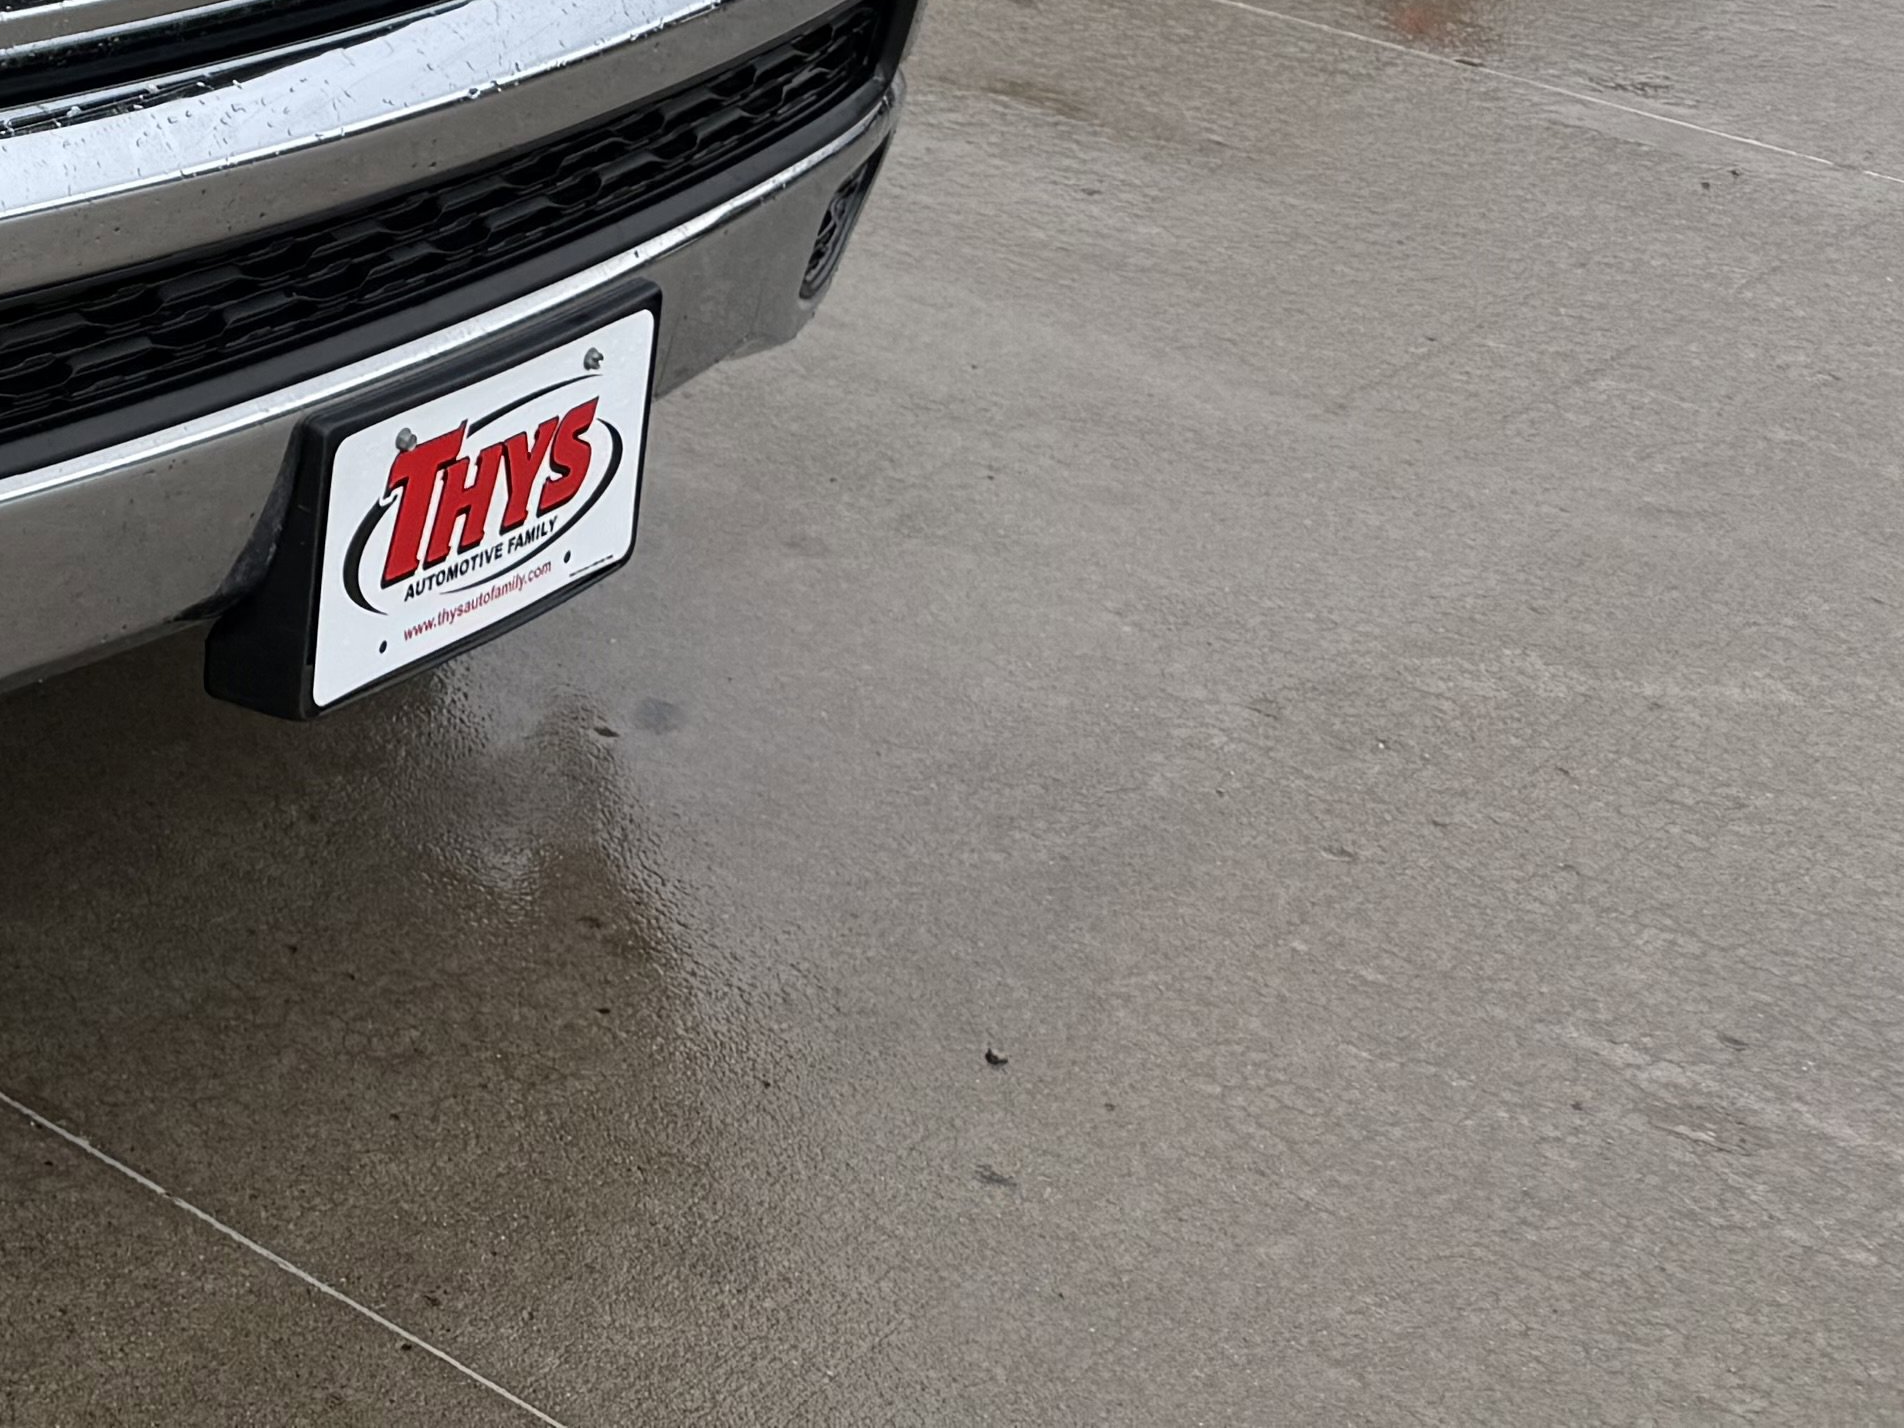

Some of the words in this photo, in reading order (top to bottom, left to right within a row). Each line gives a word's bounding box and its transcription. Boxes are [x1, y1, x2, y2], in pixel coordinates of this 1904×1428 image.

[379, 396, 600, 589] THYS
[403, 541, 504, 602] AUTOMOTIVE
[506, 515, 559, 555] FAMILY
[403, 560, 552, 642] www.thysautofamily.com
